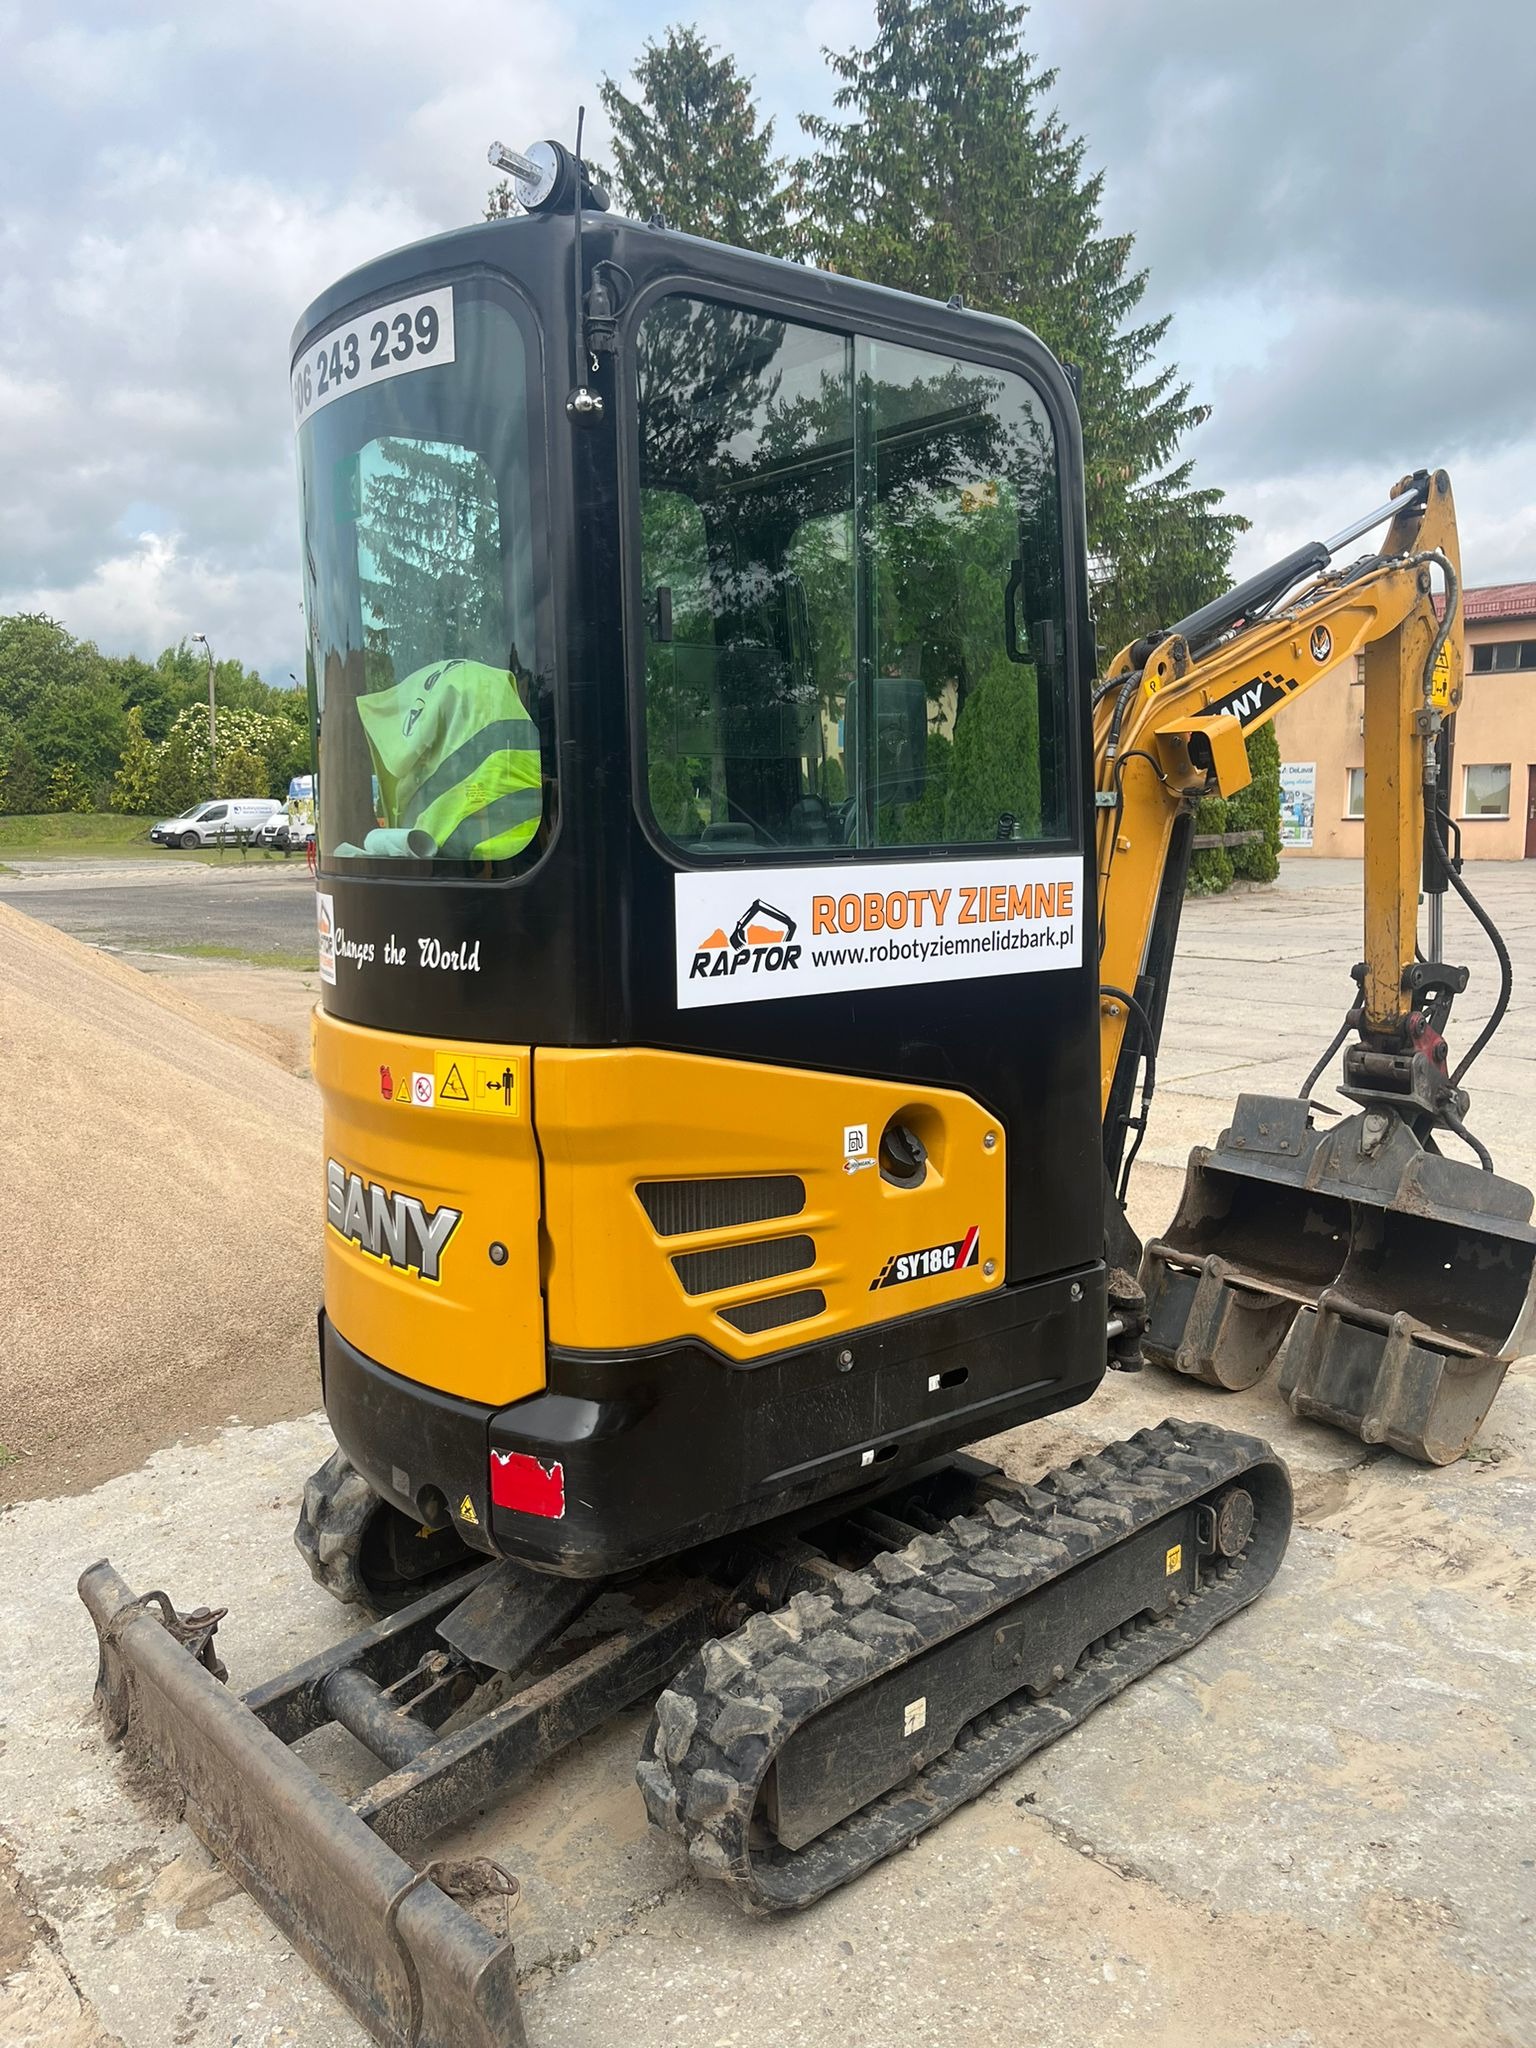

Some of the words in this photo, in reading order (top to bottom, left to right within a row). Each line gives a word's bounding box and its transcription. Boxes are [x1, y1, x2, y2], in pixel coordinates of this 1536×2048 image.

[294, 363, 312, 416] 06
[317, 333, 360, 396] 243
[370, 305, 439, 370] 239
[812, 888, 951, 936] ROBOTY
[958, 882, 1074, 927] ZIEMNE
[334, 927, 375, 972] Changes
[384, 934, 406, 967] the
[417, 937, 481, 974] World
[688, 944, 802, 979] RAPTOR
[811, 925, 1075, 968] www.robotyziemnelidzbark.pl
[326, 1158, 462, 1280] SANY
[896, 1245, 956, 1280] SY18C
